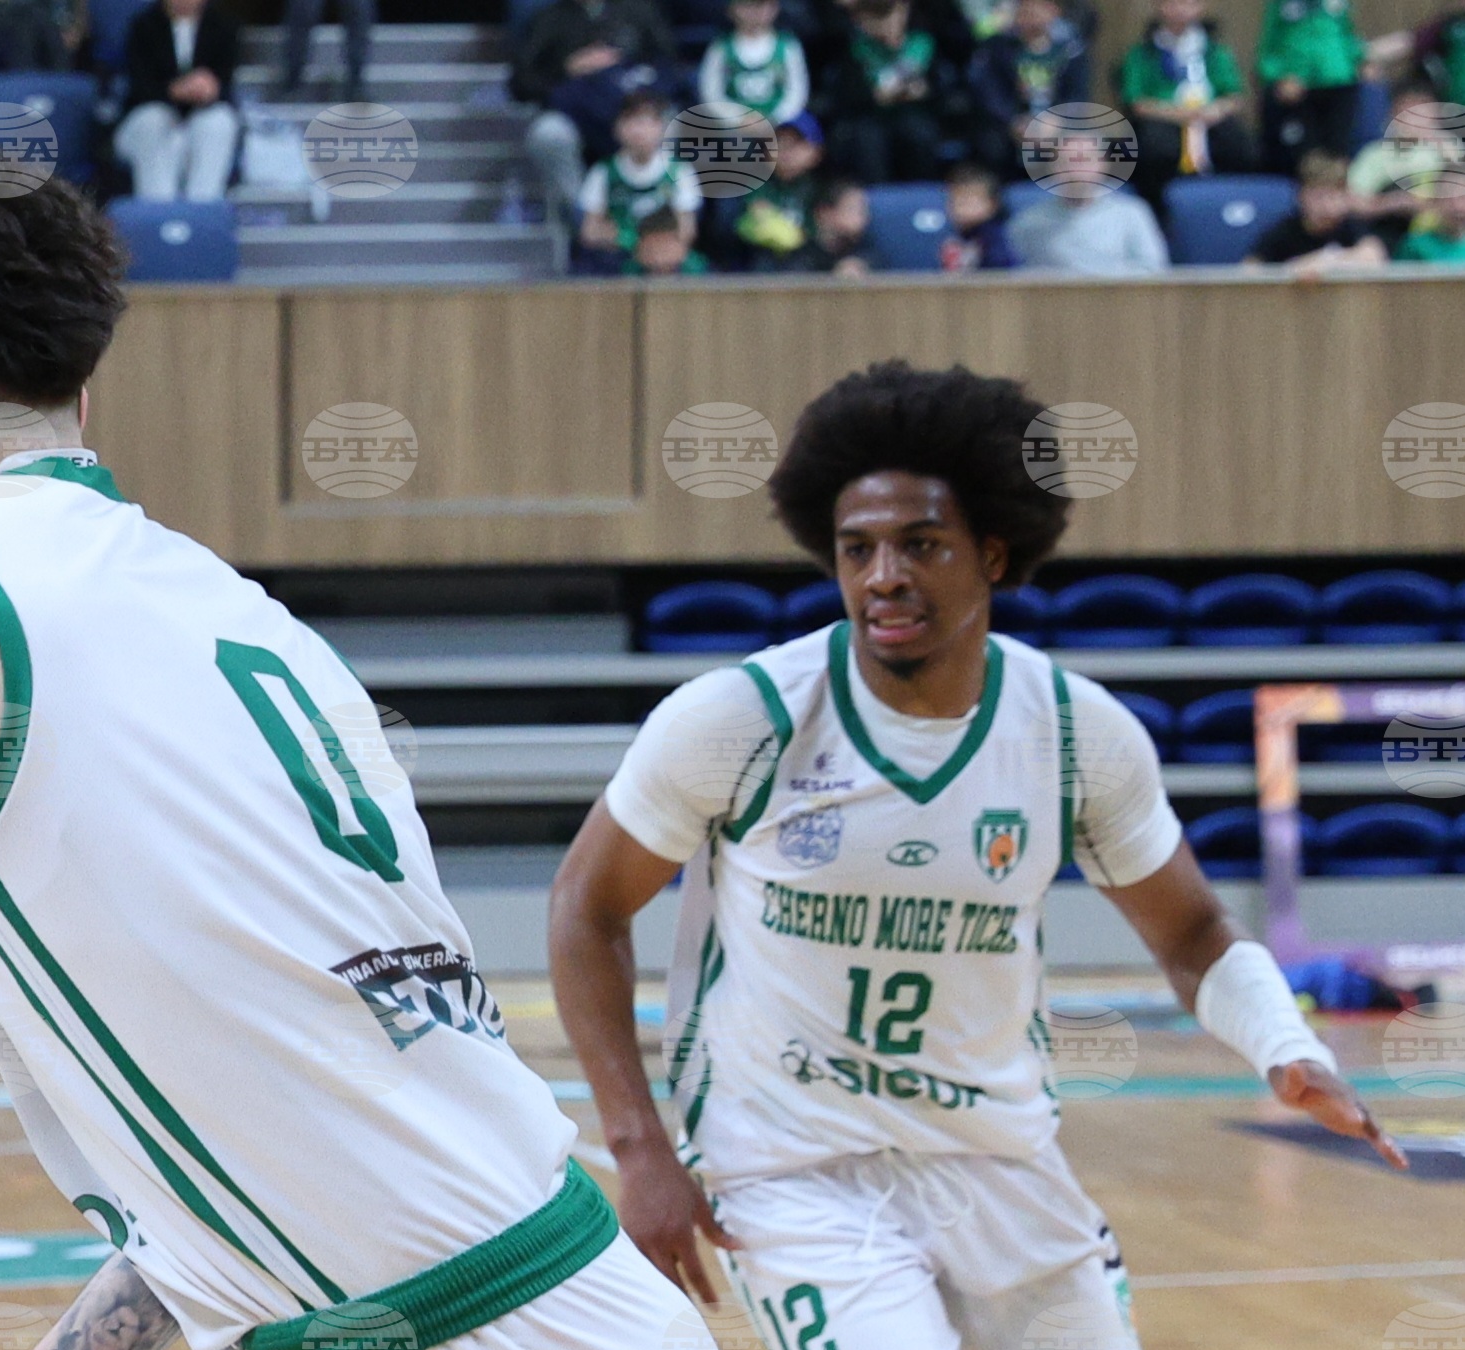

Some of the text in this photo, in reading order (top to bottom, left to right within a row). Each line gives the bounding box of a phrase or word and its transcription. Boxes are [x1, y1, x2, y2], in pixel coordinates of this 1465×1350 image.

[215, 638, 404, 883] 0
[760, 880, 869, 949] CHERNO
[872, 895, 951, 953] MORE
[843, 965, 933, 1056] 12
